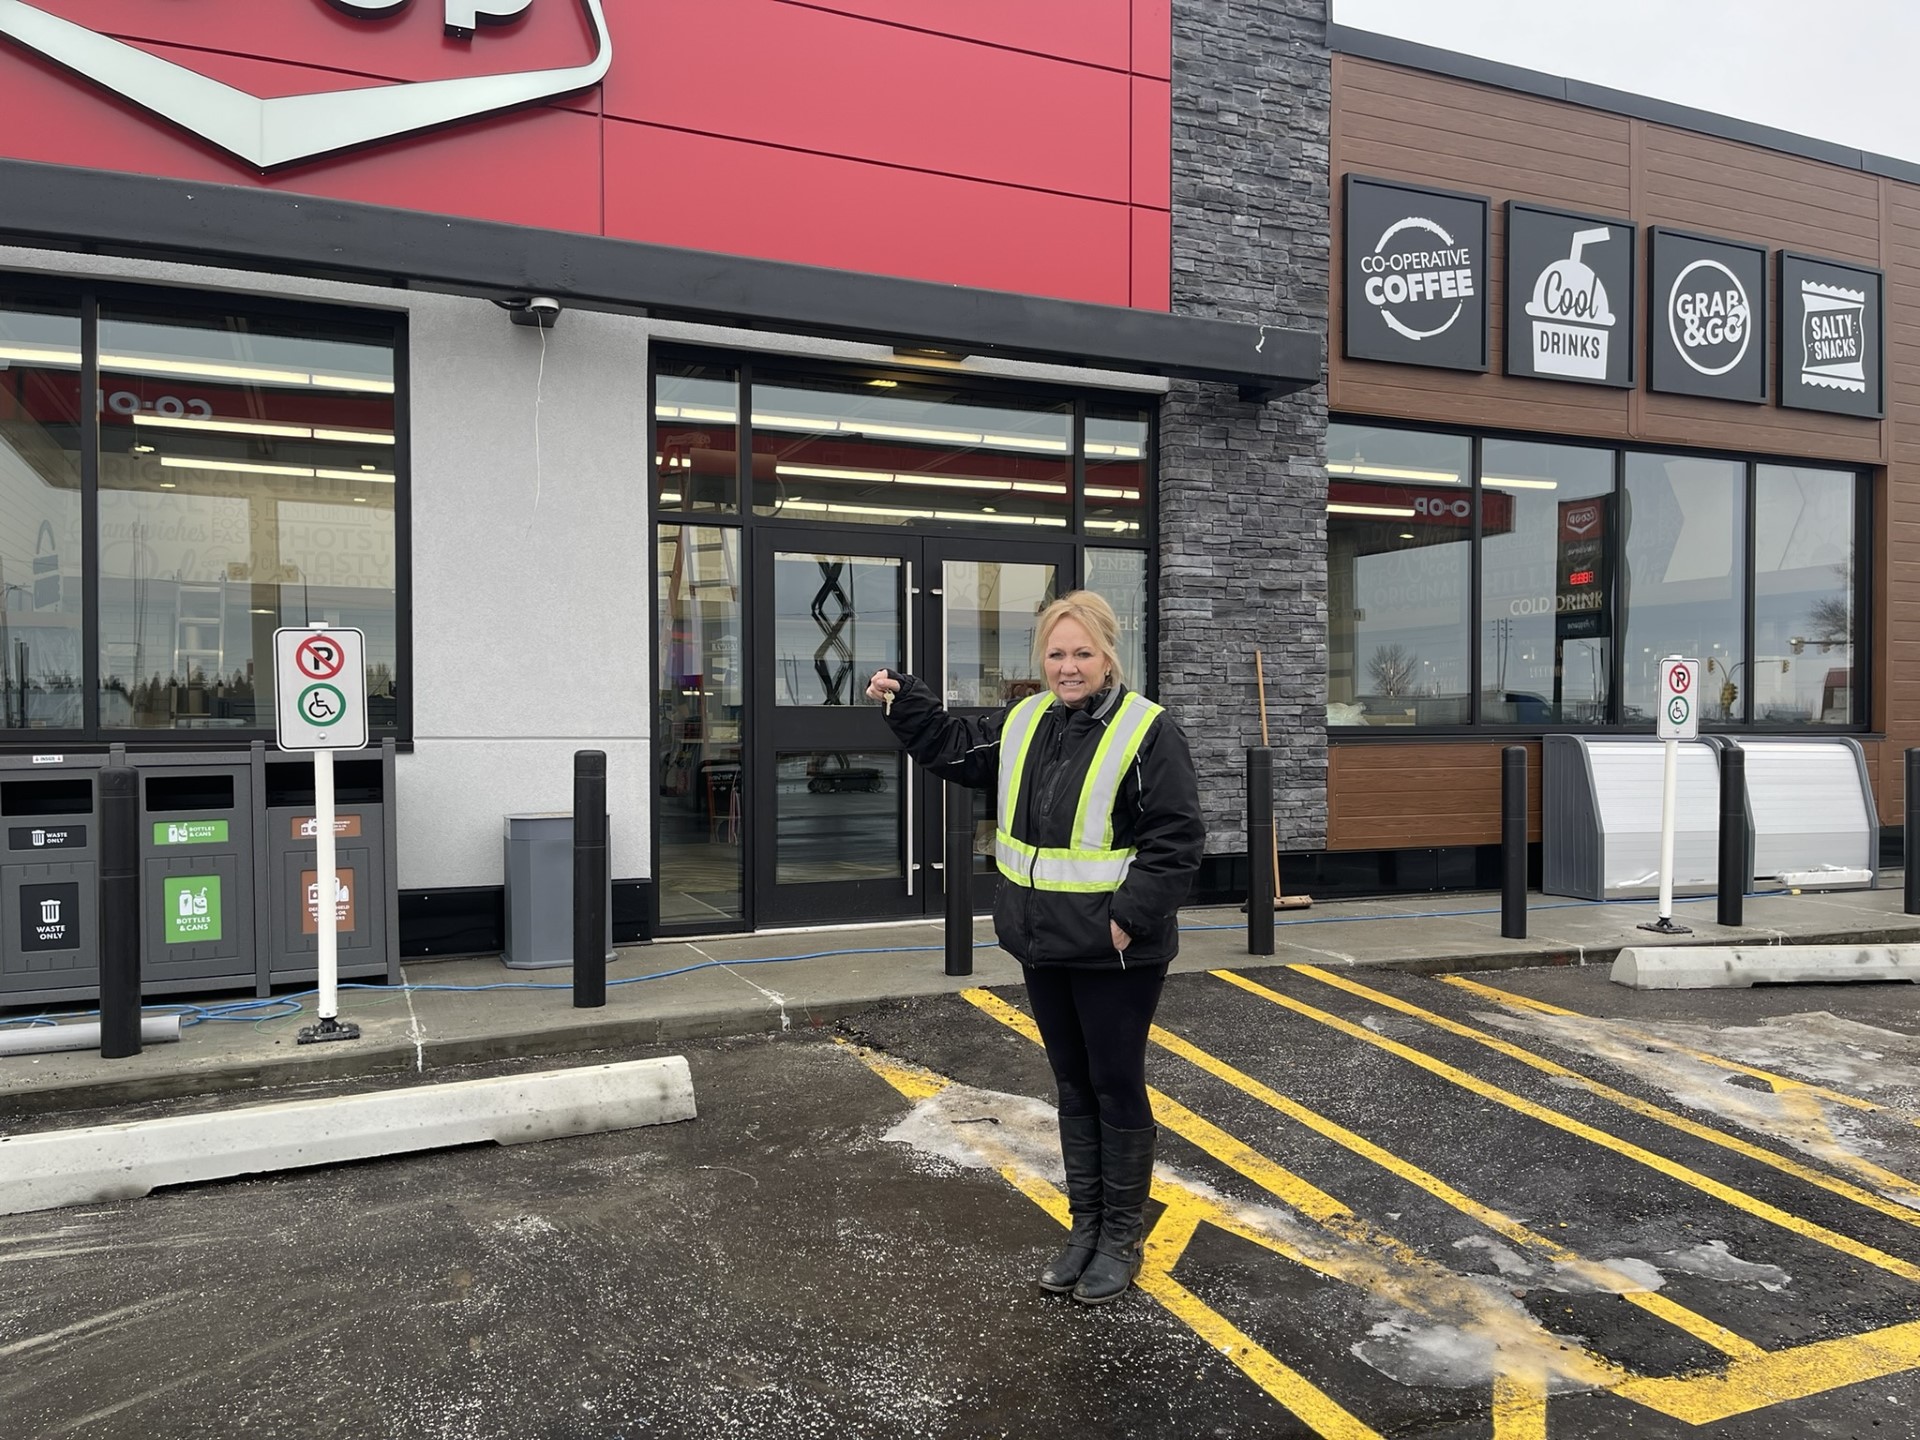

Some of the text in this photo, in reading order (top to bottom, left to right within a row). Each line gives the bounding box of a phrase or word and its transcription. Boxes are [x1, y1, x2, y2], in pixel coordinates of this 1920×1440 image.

[1361, 248, 1471, 273] CO-OPERATIVE
[1365, 268, 1475, 306] COFFEE
[1543, 270, 1599, 320] Cool
[1676, 289, 1740, 320] GRAB
[1811, 314, 1852, 340] SALTY
[1540, 330, 1600, 360] DRINKS
[1814, 337, 1857, 361] SNACKS
[1510, 597, 1551, 616] COLD
[36, 924, 66, 933] WASTE
[176, 916, 211, 925] BOTTLES
[186, 923, 209, 931] CANS
[39, 932, 63, 940] ONLY
